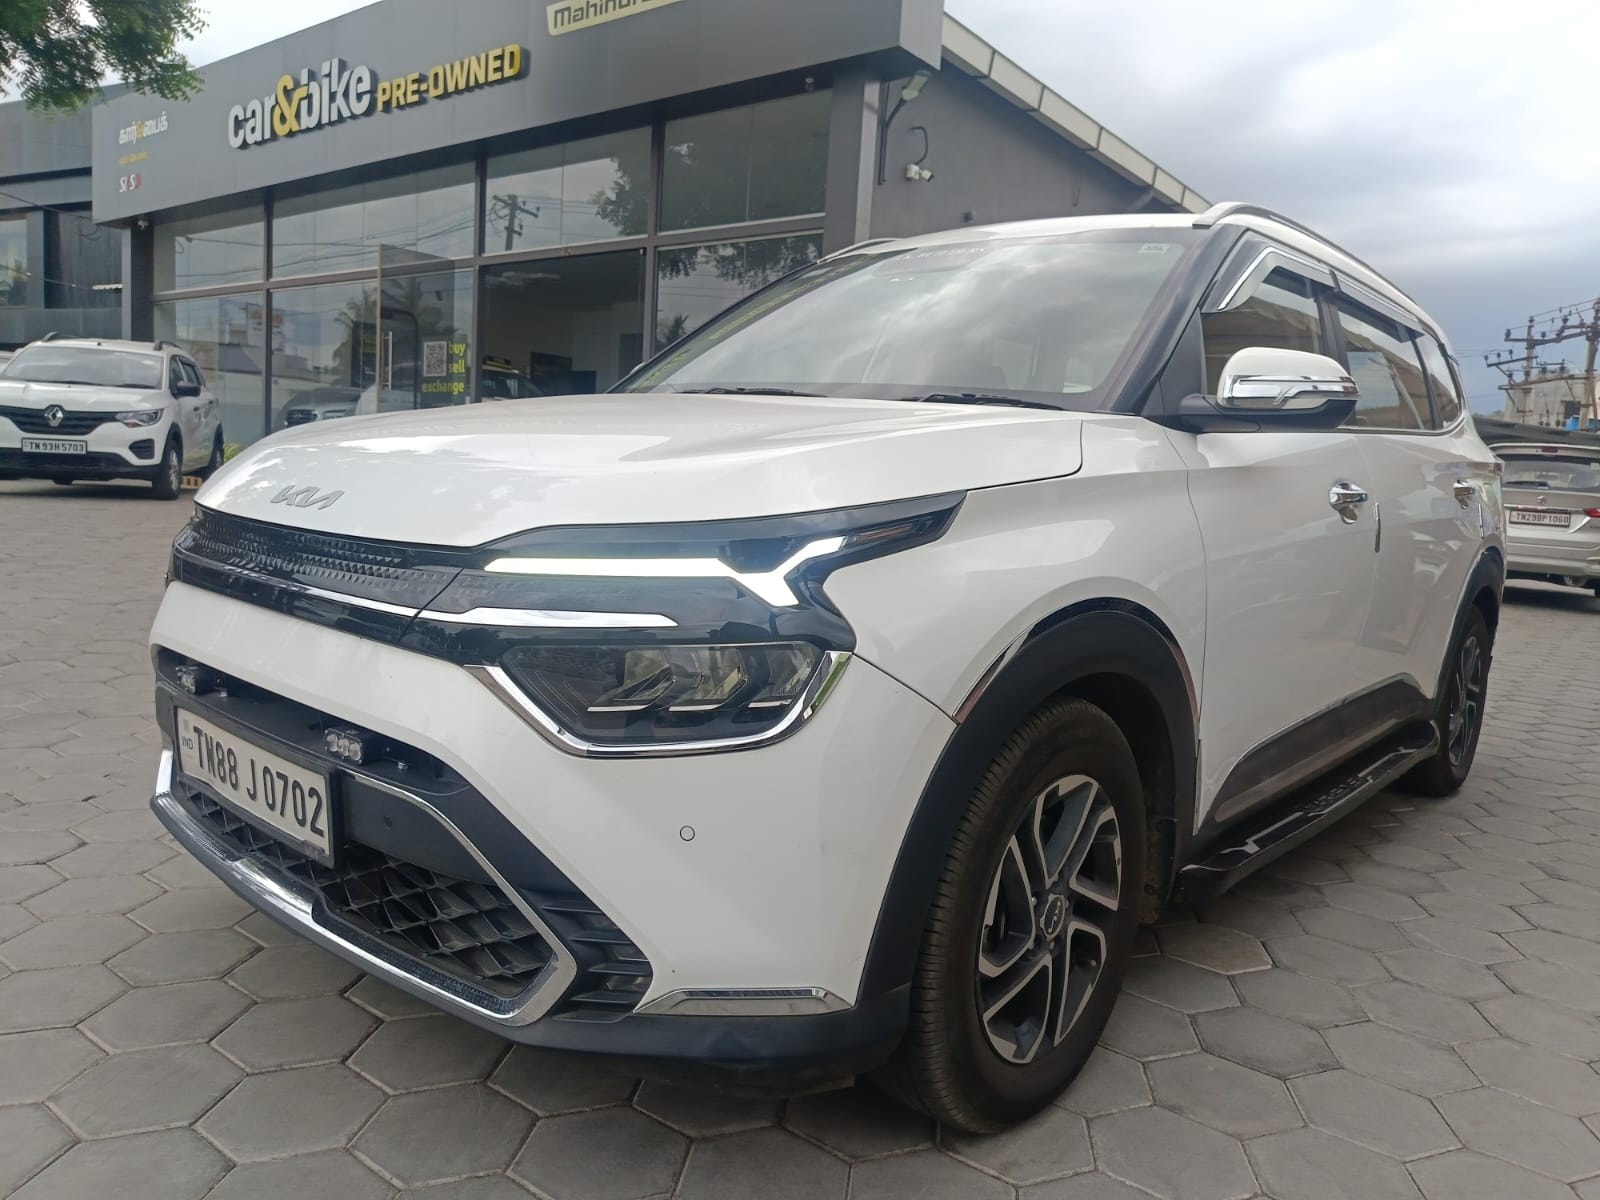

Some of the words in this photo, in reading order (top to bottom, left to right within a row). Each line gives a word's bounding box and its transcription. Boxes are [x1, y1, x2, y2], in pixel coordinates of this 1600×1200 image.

[554, 0, 655, 28] Mahin
[228, 57, 372, 149] car&bike
[377, 44, 520, 112] PRE-OWNED
[448, 359, 465, 373] sell
[422, 379, 465, 396] exchange
